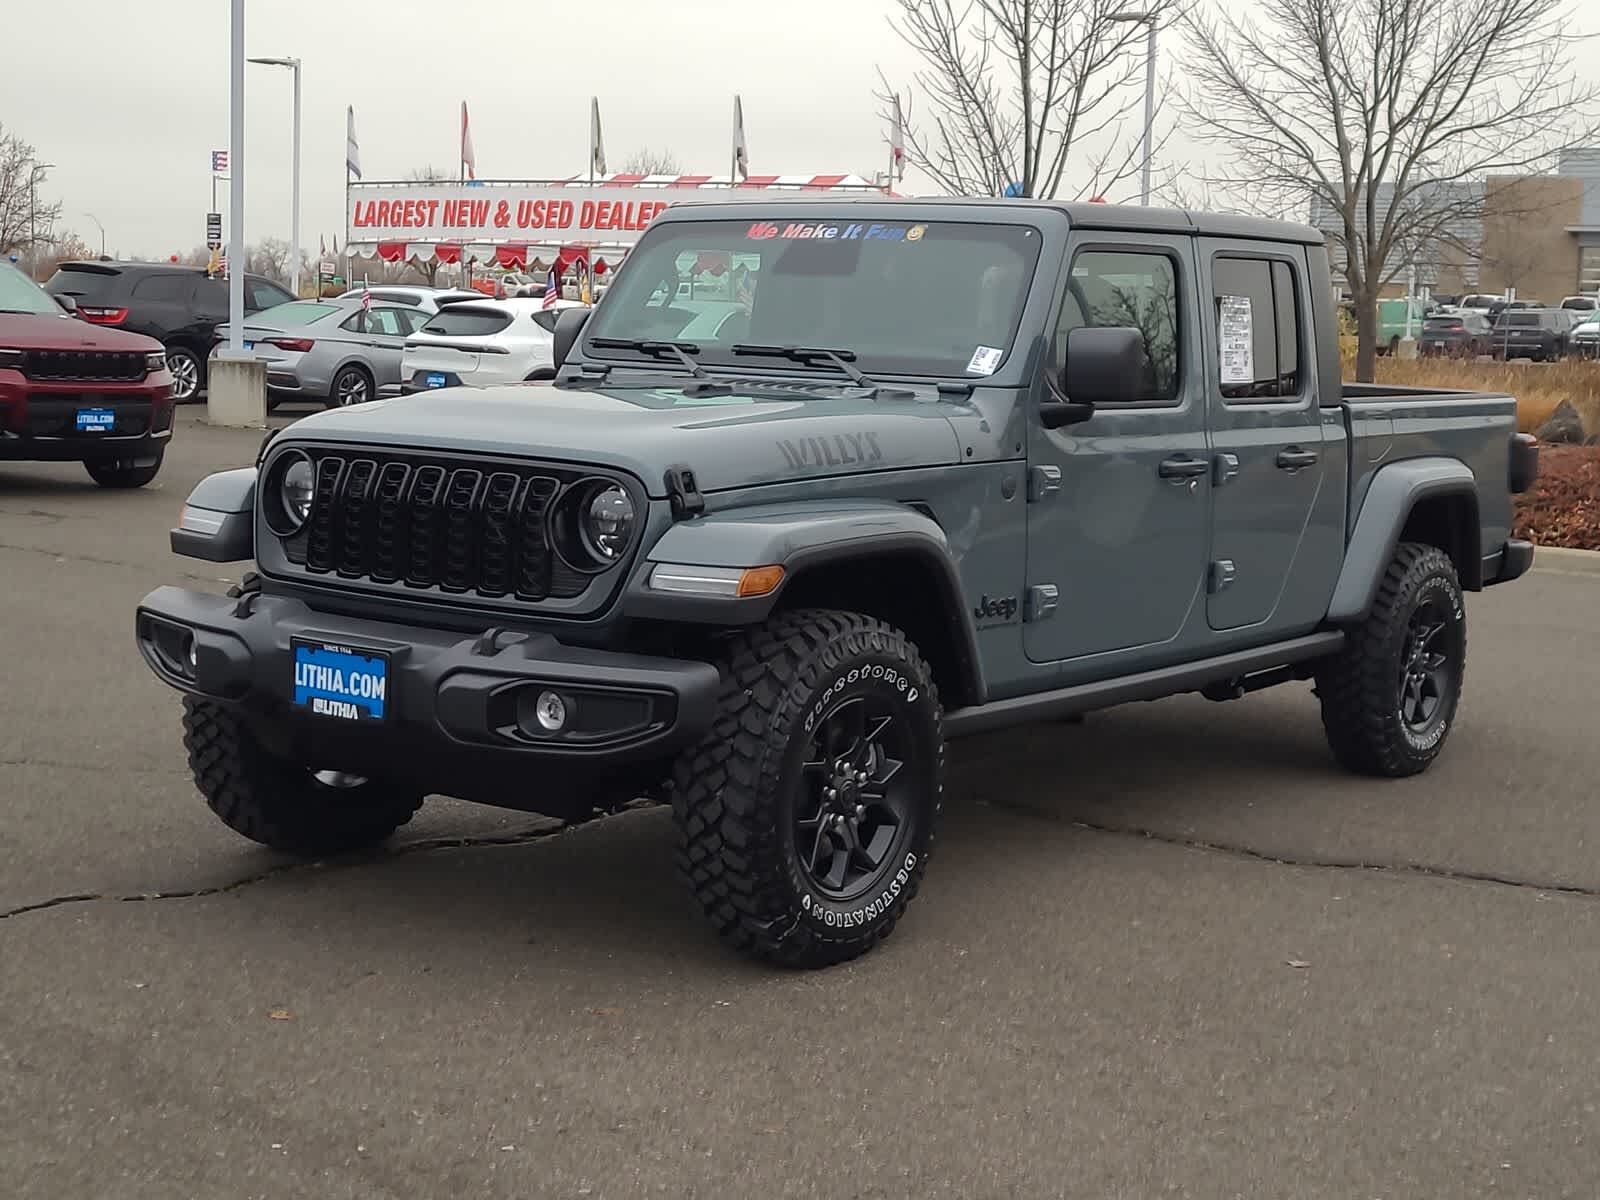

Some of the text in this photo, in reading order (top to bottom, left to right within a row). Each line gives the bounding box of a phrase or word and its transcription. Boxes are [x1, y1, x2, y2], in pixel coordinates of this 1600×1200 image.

[353, 200, 439, 228] LARGEST
[442, 200, 490, 228] NEW
[493, 201, 511, 228] &
[516, 201, 572, 229] USED
[747, 223, 778, 240] We
[781, 223, 838, 240] Make
[841, 224, 863, 239] It
[776, 432, 882, 469] WILLYS
[974, 596, 1016, 621] Jeep
[295, 662, 386, 701] LITHIA.COM
[812, 852, 917, 928] DESTINATION
